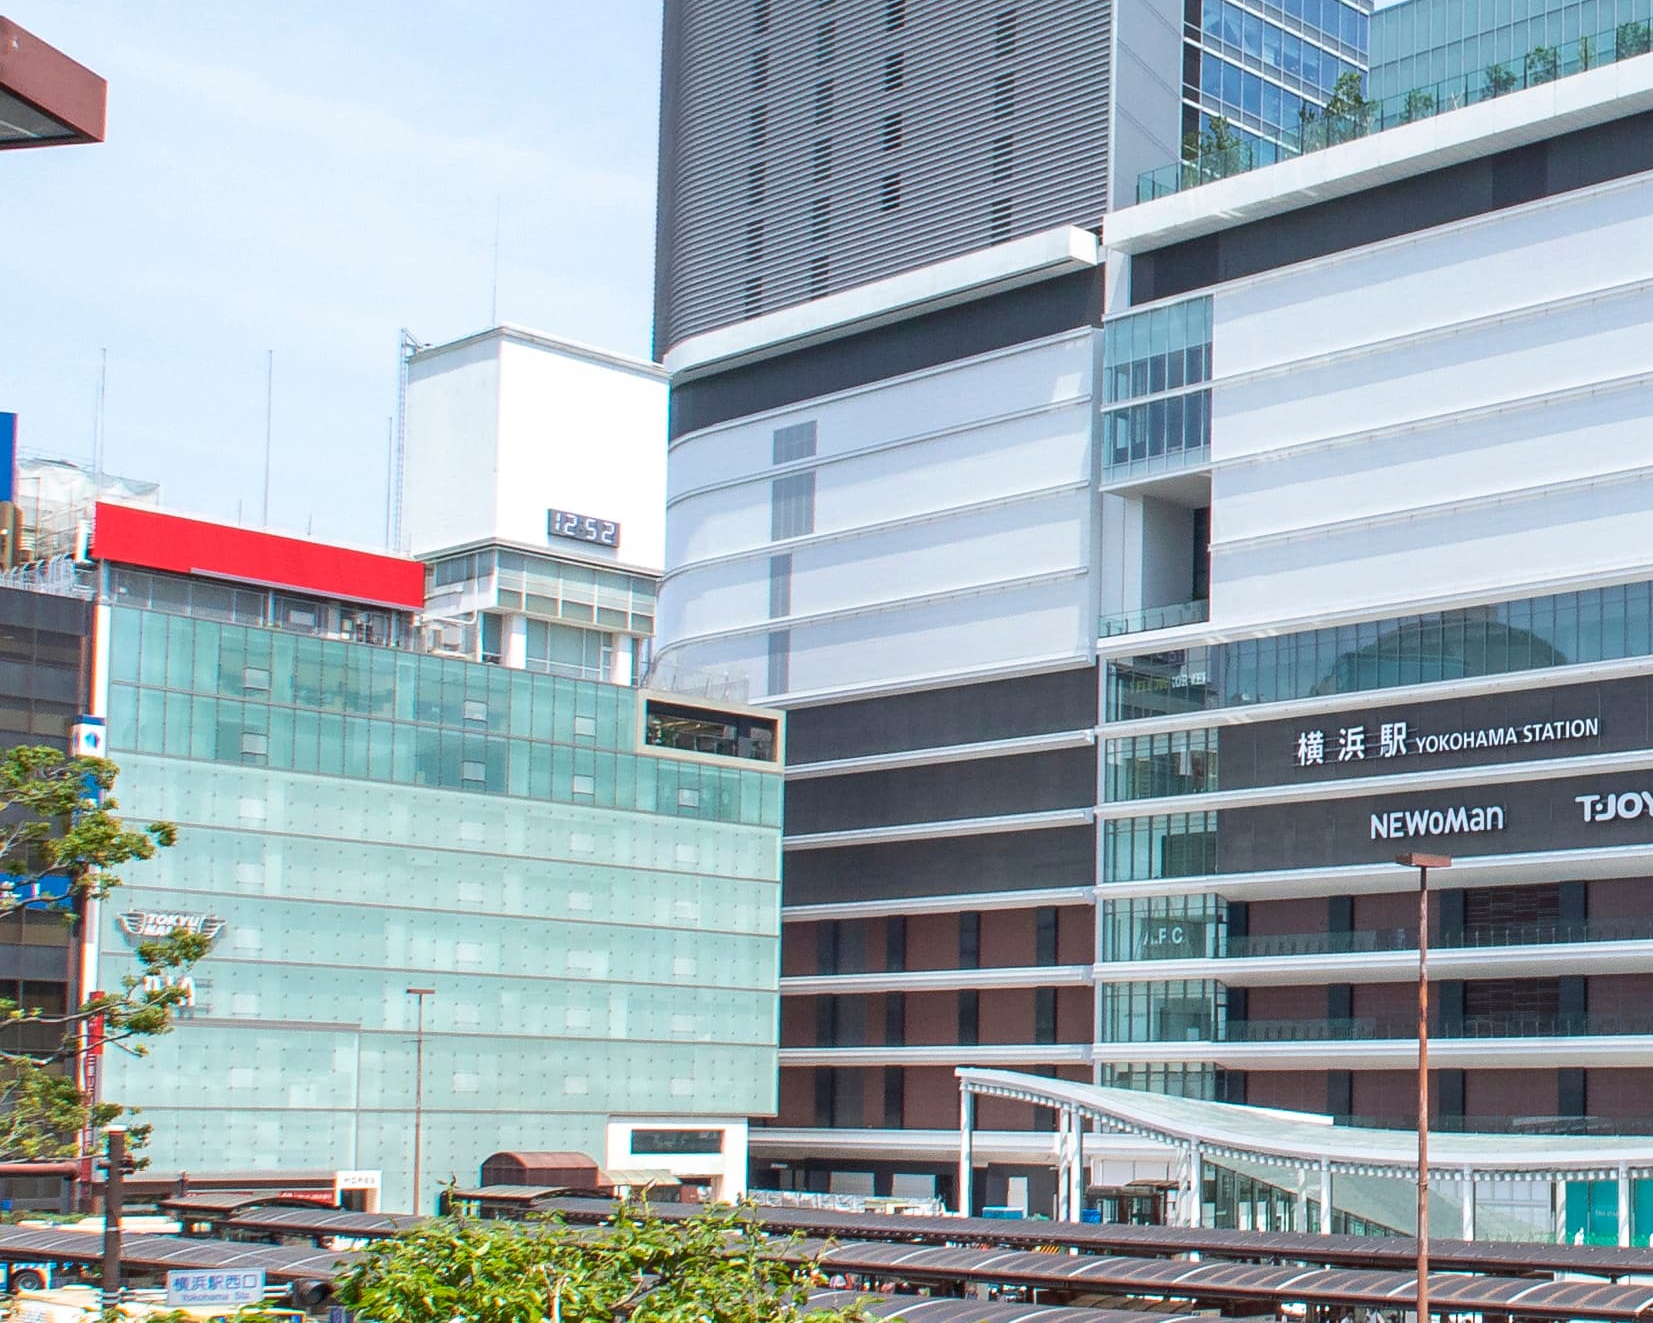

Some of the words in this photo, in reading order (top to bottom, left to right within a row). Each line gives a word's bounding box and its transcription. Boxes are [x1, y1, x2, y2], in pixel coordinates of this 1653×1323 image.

[1298, 722, 1406, 766] 横浜駅
[1416, 728, 1517, 754] YOKOHAMA
[1523, 718, 1598, 742] STATION
[174, 1275, 257, 1292] 横浜駅西口
